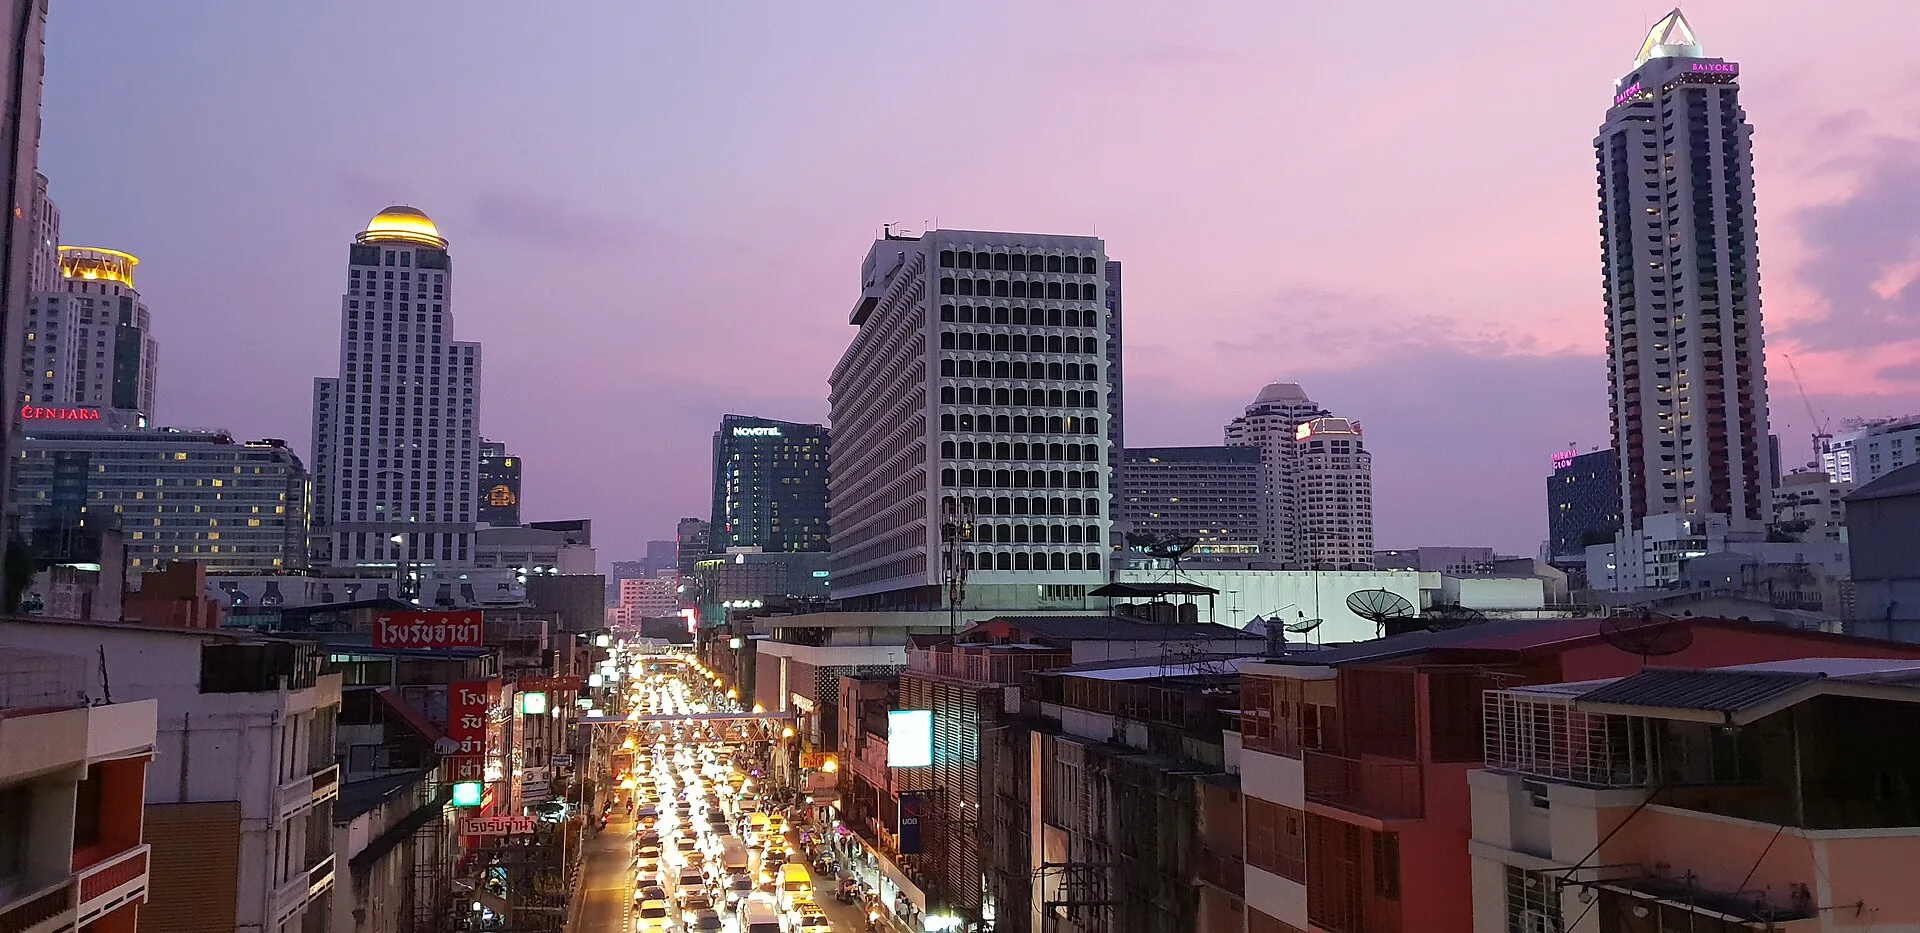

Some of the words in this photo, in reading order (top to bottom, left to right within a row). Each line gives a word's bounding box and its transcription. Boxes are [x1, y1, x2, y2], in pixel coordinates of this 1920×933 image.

[1692, 63, 1735, 72] BAIYOKE
[733, 427, 781, 436] NOVOTEL
[377, 617, 479, 644] โรงรับจำนำ
[459, 689, 486, 706] โรง
[461, 714, 482, 729] รับ
